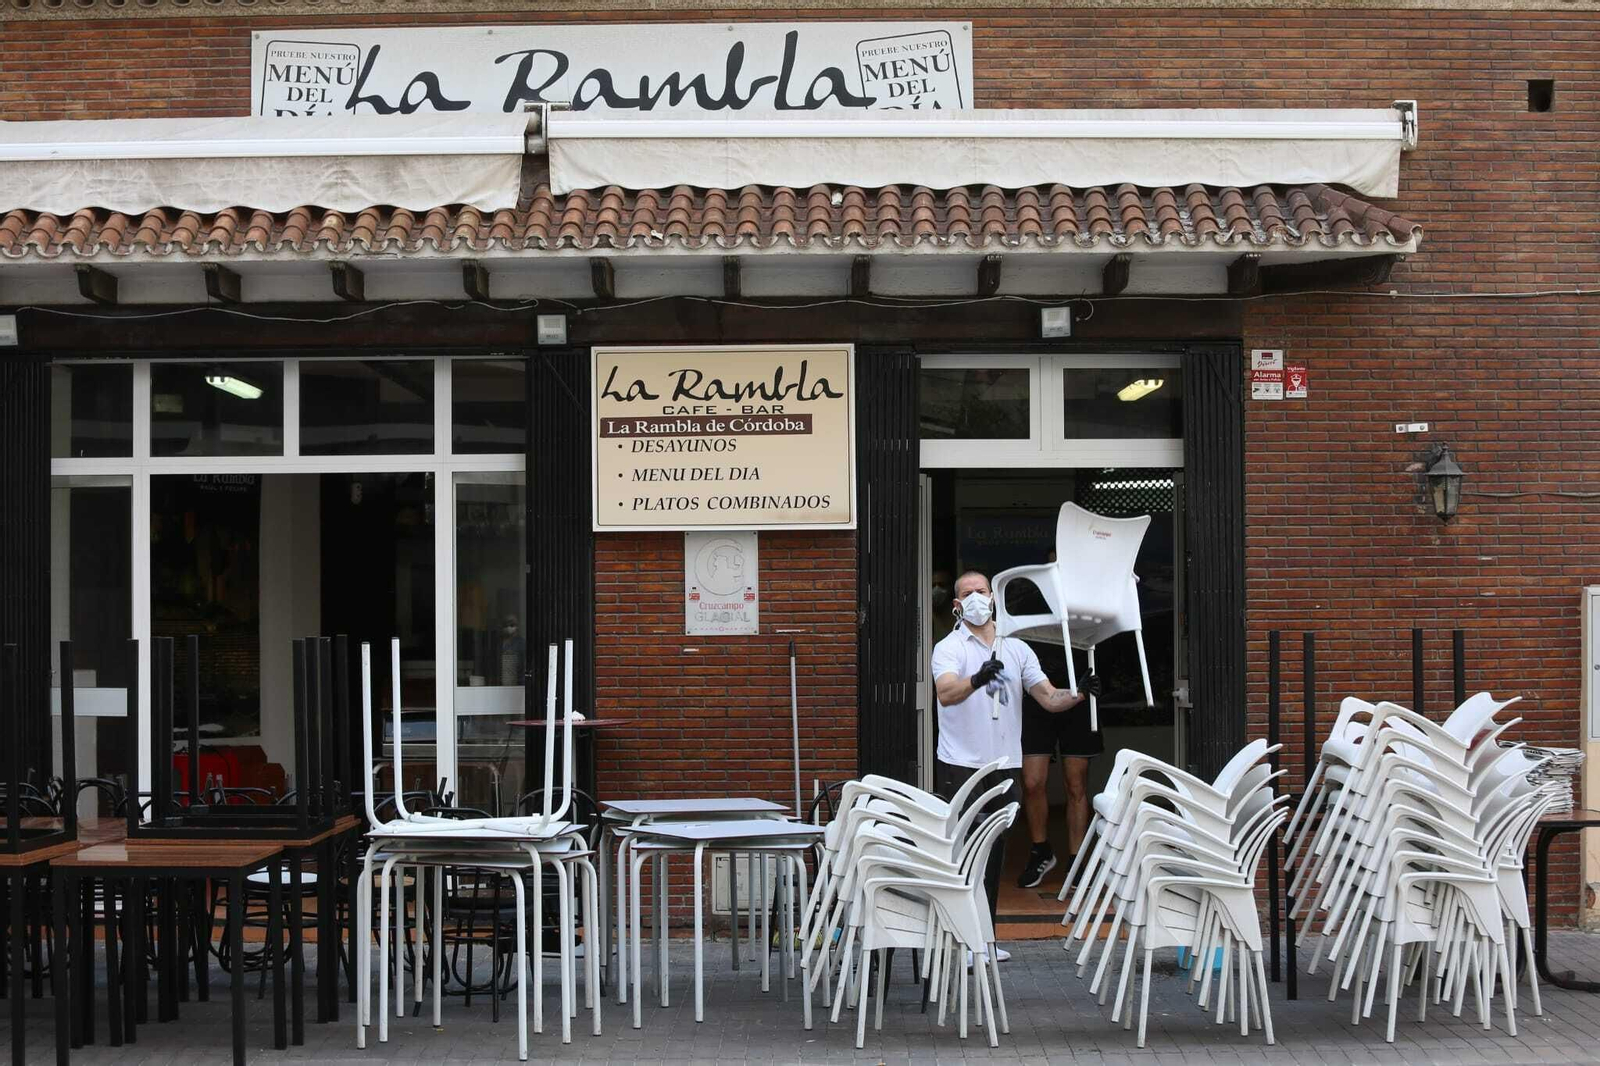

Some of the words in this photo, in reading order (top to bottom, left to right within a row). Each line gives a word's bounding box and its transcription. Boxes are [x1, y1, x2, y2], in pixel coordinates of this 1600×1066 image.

[270, 50, 307, 59] PRUEBE
[310, 52, 356, 61] NUESTRO
[861, 46, 900, 58] PRUEBE
[901, 40, 948, 52] NUESTRO
[346, 44, 471, 115] La
[494, 30, 877, 113] Rambla
[863, 48, 950, 82] MENÚ
[267, 62, 356, 86] MENÚ
[286, 86, 334, 104] DEL
[888, 78, 936, 98] DEL
[601, 365, 660, 402] La
[668, 360, 844, 403] Rambla
[662, 405, 718, 415] CAFE
[741, 404, 785, 414] BAR
[607, 421, 630, 434] La
[634, 419, 701, 434] Rambla
[706, 419, 726, 433] de
[729, 418, 805, 432] Córdoba
[631, 438, 737, 453] DESAYUNOS
[632, 468, 686, 482] MENU
[690, 467, 724, 481] DEL
[729, 467, 760, 481] DIA
[632, 497, 700, 511] PLATOS
[707, 495, 831, 511] COMBINADOS
[699, 602, 744, 610] Cruzcampo
